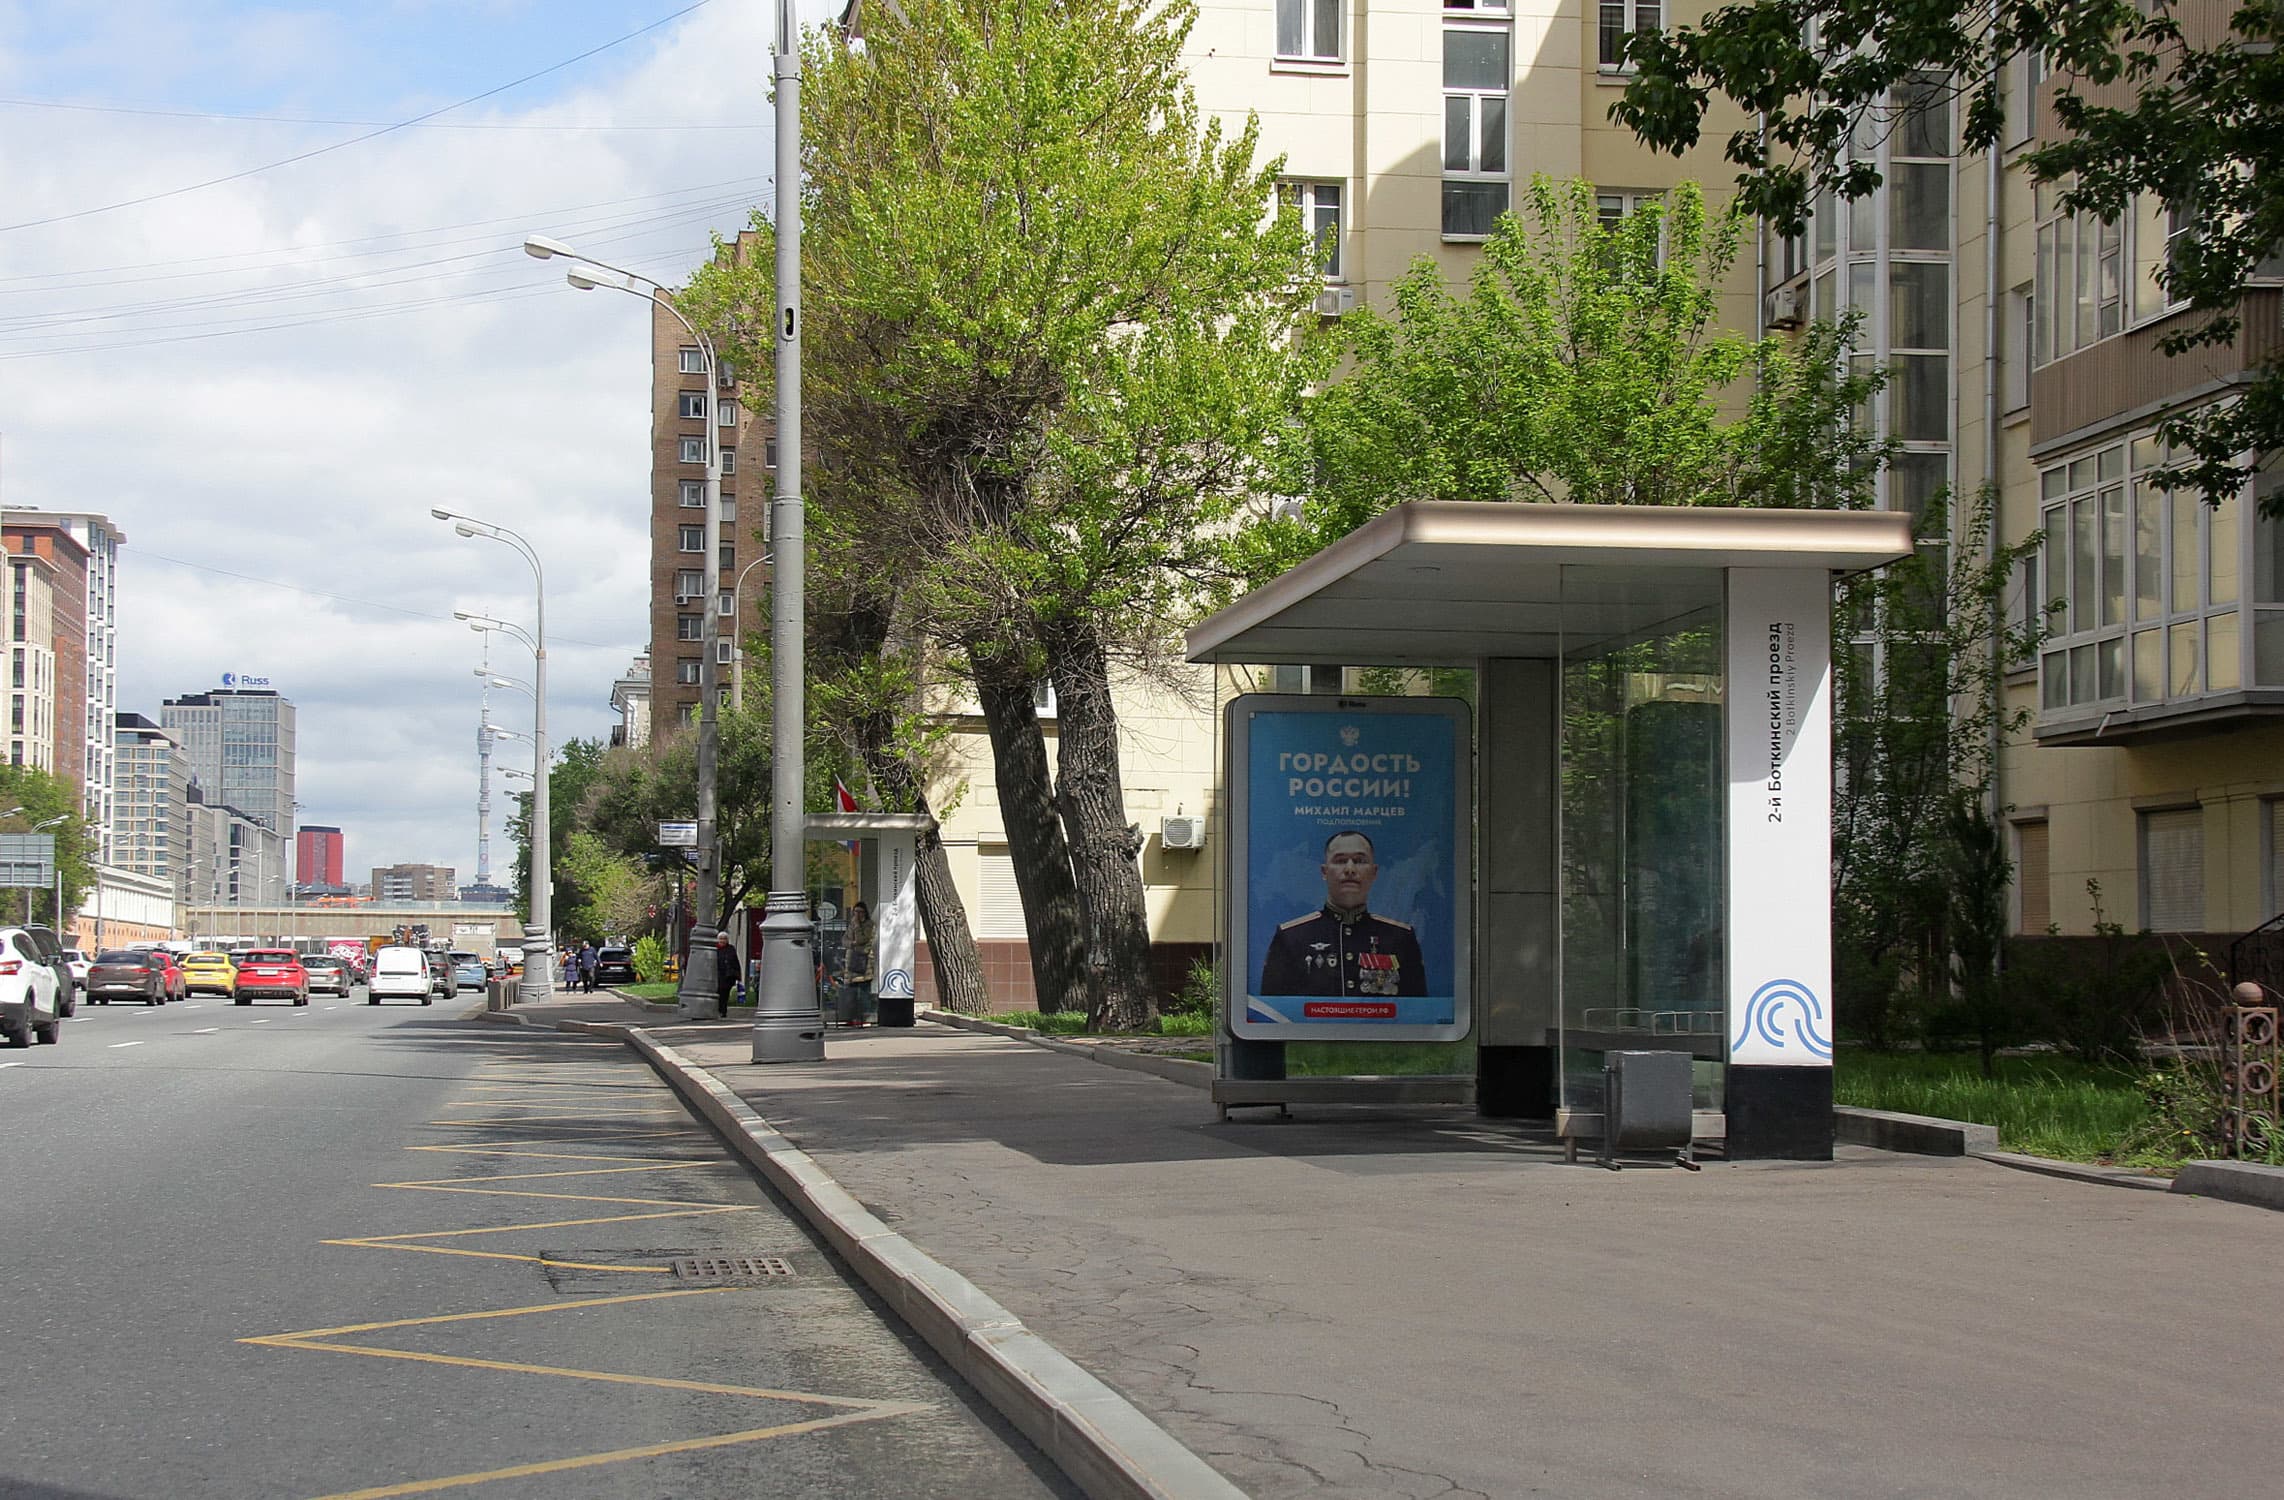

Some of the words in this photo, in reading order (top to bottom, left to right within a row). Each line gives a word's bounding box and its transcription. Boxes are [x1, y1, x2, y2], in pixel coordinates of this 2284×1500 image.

[1769, 622, 1784, 685] проезд
[1785, 623, 1796, 662] Proezd
[241, 675, 270, 685] Russ
[1785, 664, 1796, 725] Botkinskiy
[1766, 690, 1782, 791] Боткинский
[1786, 728, 1796, 736] 2
[1279, 752, 1421, 775] ГОРДОСТЬ
[1288, 777, 1410, 798] РОССИИ!
[1294, 806, 1350, 816] МИХАИЛ
[1353, 807, 1406, 817] МАРЦЕВ
[1767, 798, 1782, 823] 2-й
